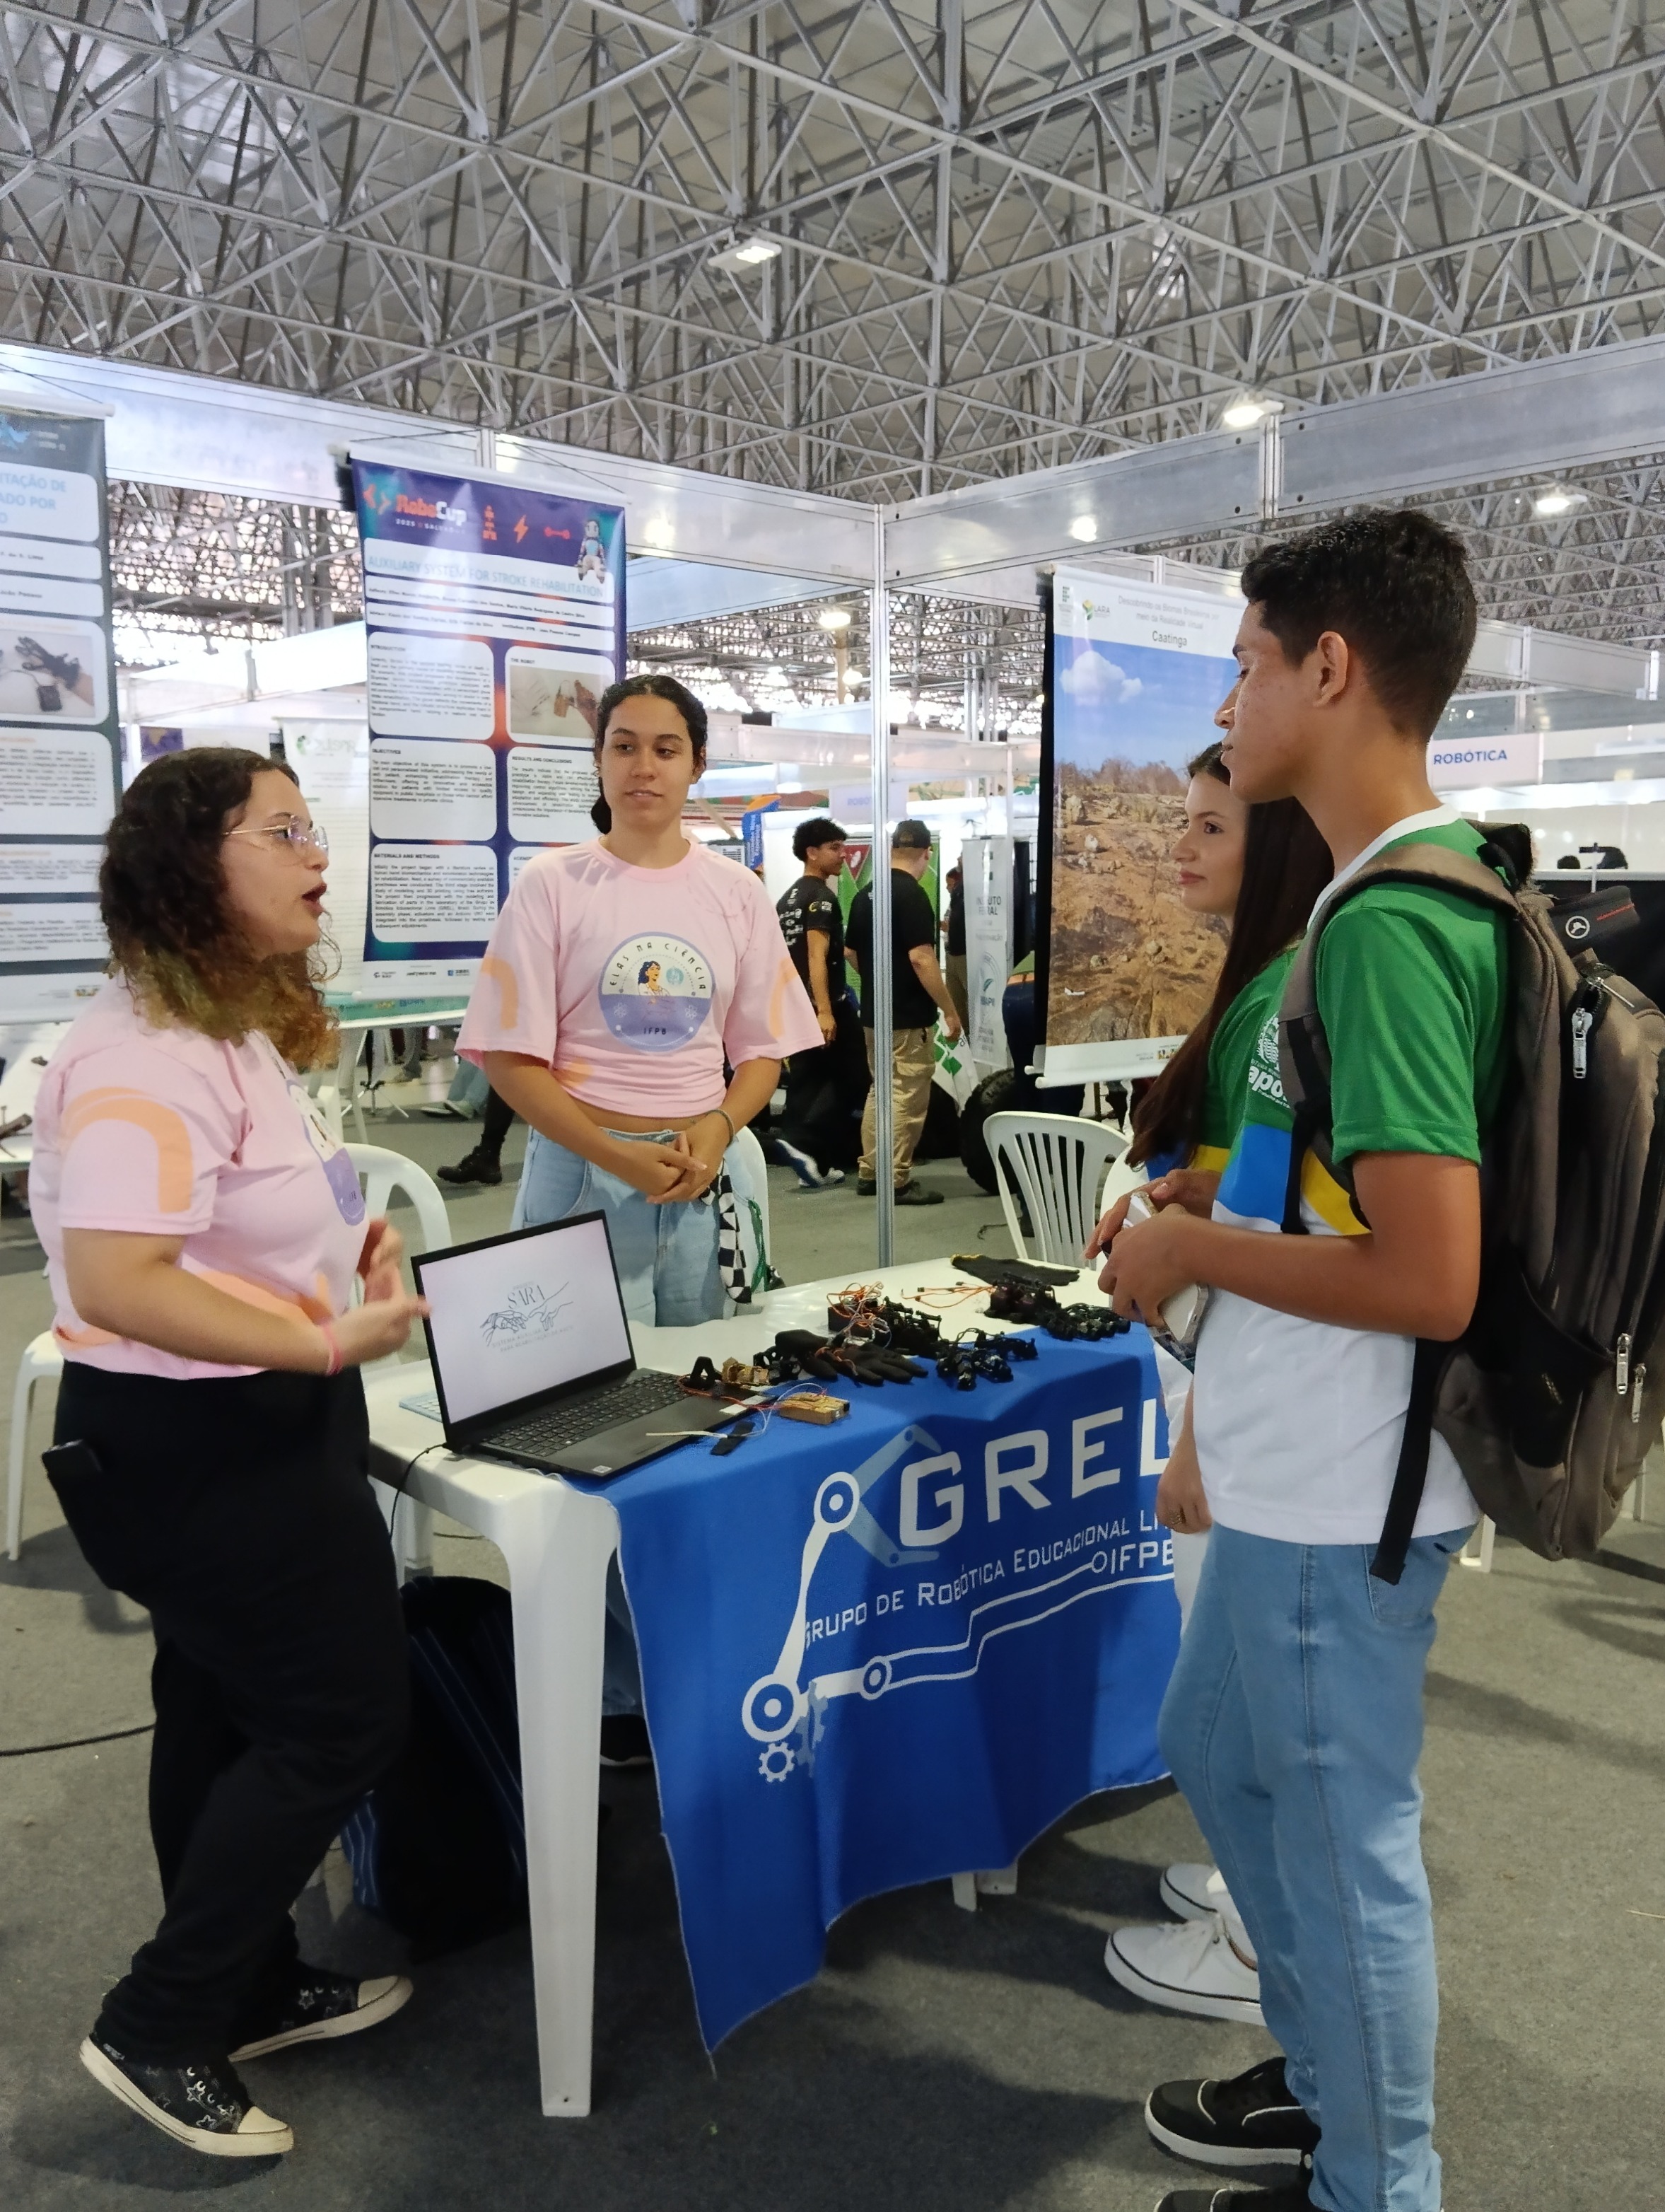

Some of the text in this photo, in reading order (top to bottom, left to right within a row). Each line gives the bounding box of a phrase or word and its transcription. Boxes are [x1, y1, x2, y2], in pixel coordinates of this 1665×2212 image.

[51, 479, 67, 492] DE
[30, 496, 57, 511] POR
[395, 494, 467, 527] RoboCup
[369, 557, 603, 597] AUXILIARY SYSTEM FOR STROKE REHABILITATION
[1152, 630, 1187, 648] Caatinga
[1434, 749, 1507, 765] ROBÓTICA
[609, 942, 706, 989] ELAS NA CIÊNCIA
[643, 1027, 667, 1035] IFPB
[508, 1284, 545, 1309] SARA
[899, 1398, 1171, 1547] GREL
[876, 1589, 904, 1617] DE
[918, 1559, 1006, 1607] ROBÓTICA
[1014, 1518, 1130, 1573] EDUCACIONAL
[1140, 1509, 1168, 1532] LI
